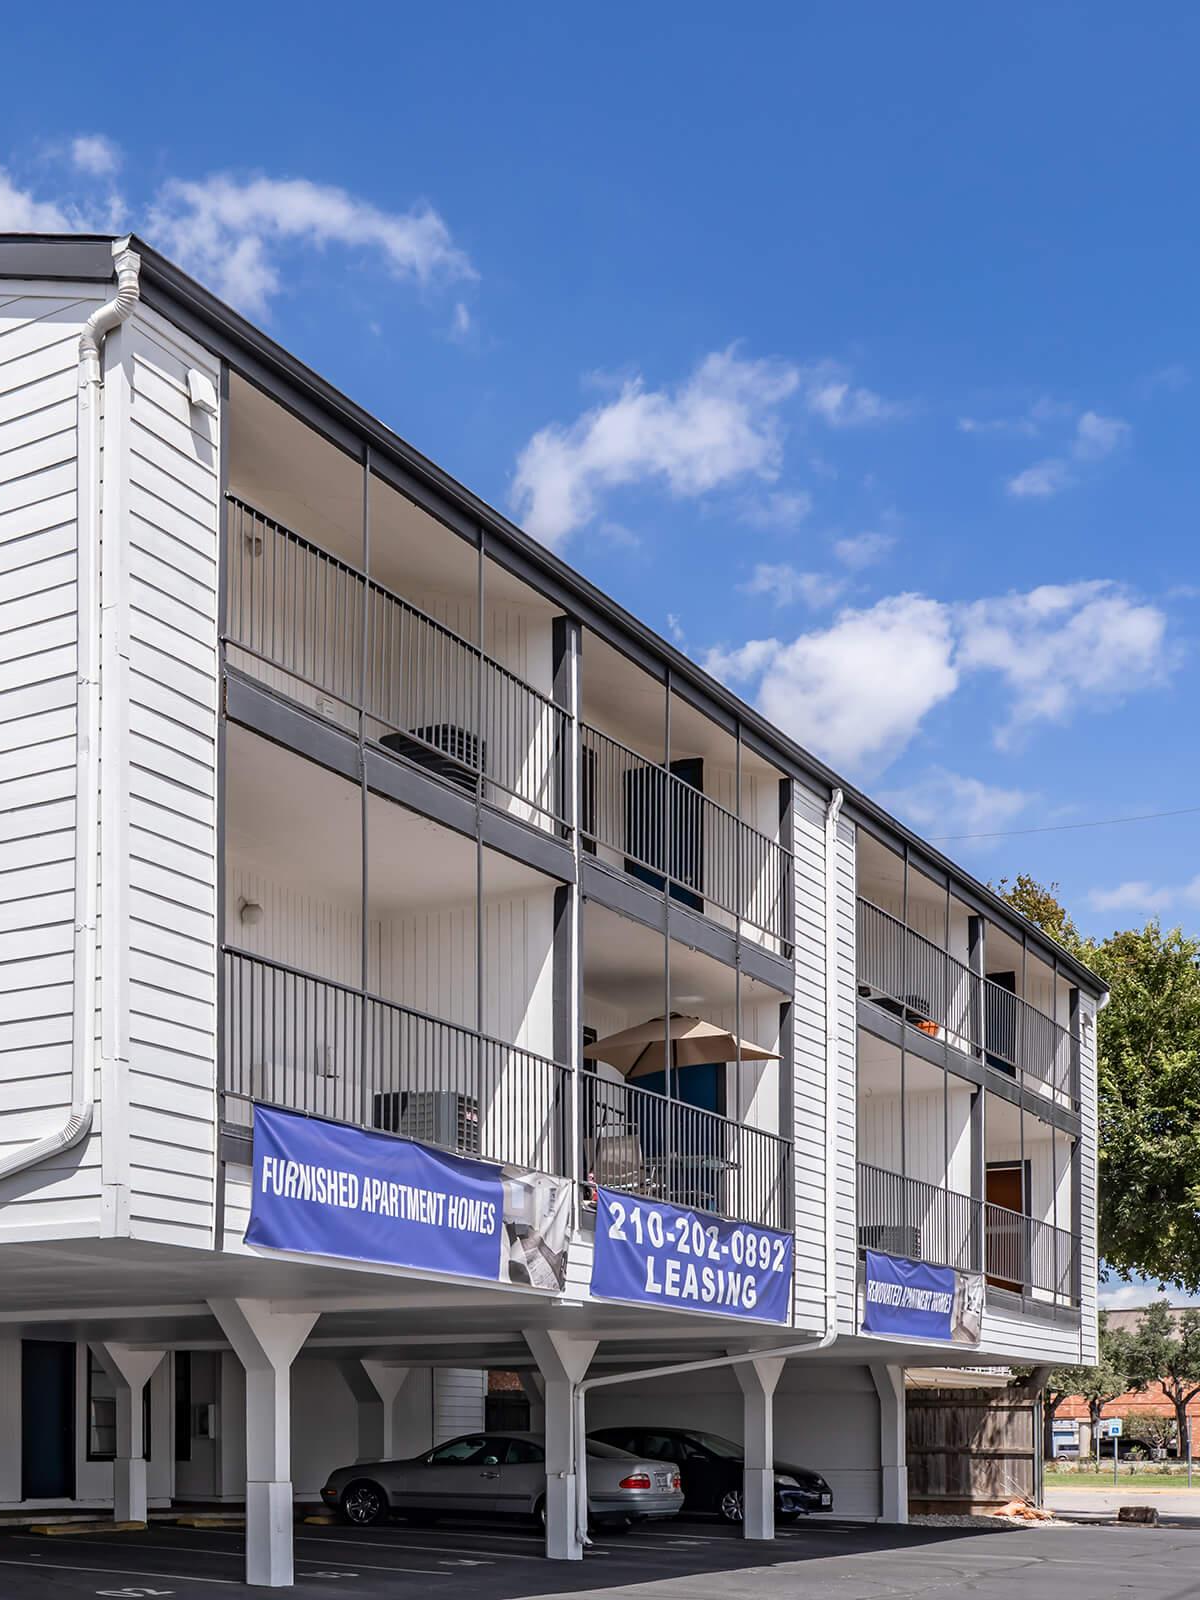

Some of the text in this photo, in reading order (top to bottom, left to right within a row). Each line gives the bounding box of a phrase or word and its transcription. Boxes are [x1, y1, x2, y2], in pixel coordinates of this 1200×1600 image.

[261, 1155, 496, 1236] FURNISHED APARTMENT HOMES
[608, 1201, 785, 1273] 210-202-0892
[644, 1255, 758, 1310] LEASING
[867, 1280, 903, 1306] RENOVATED
